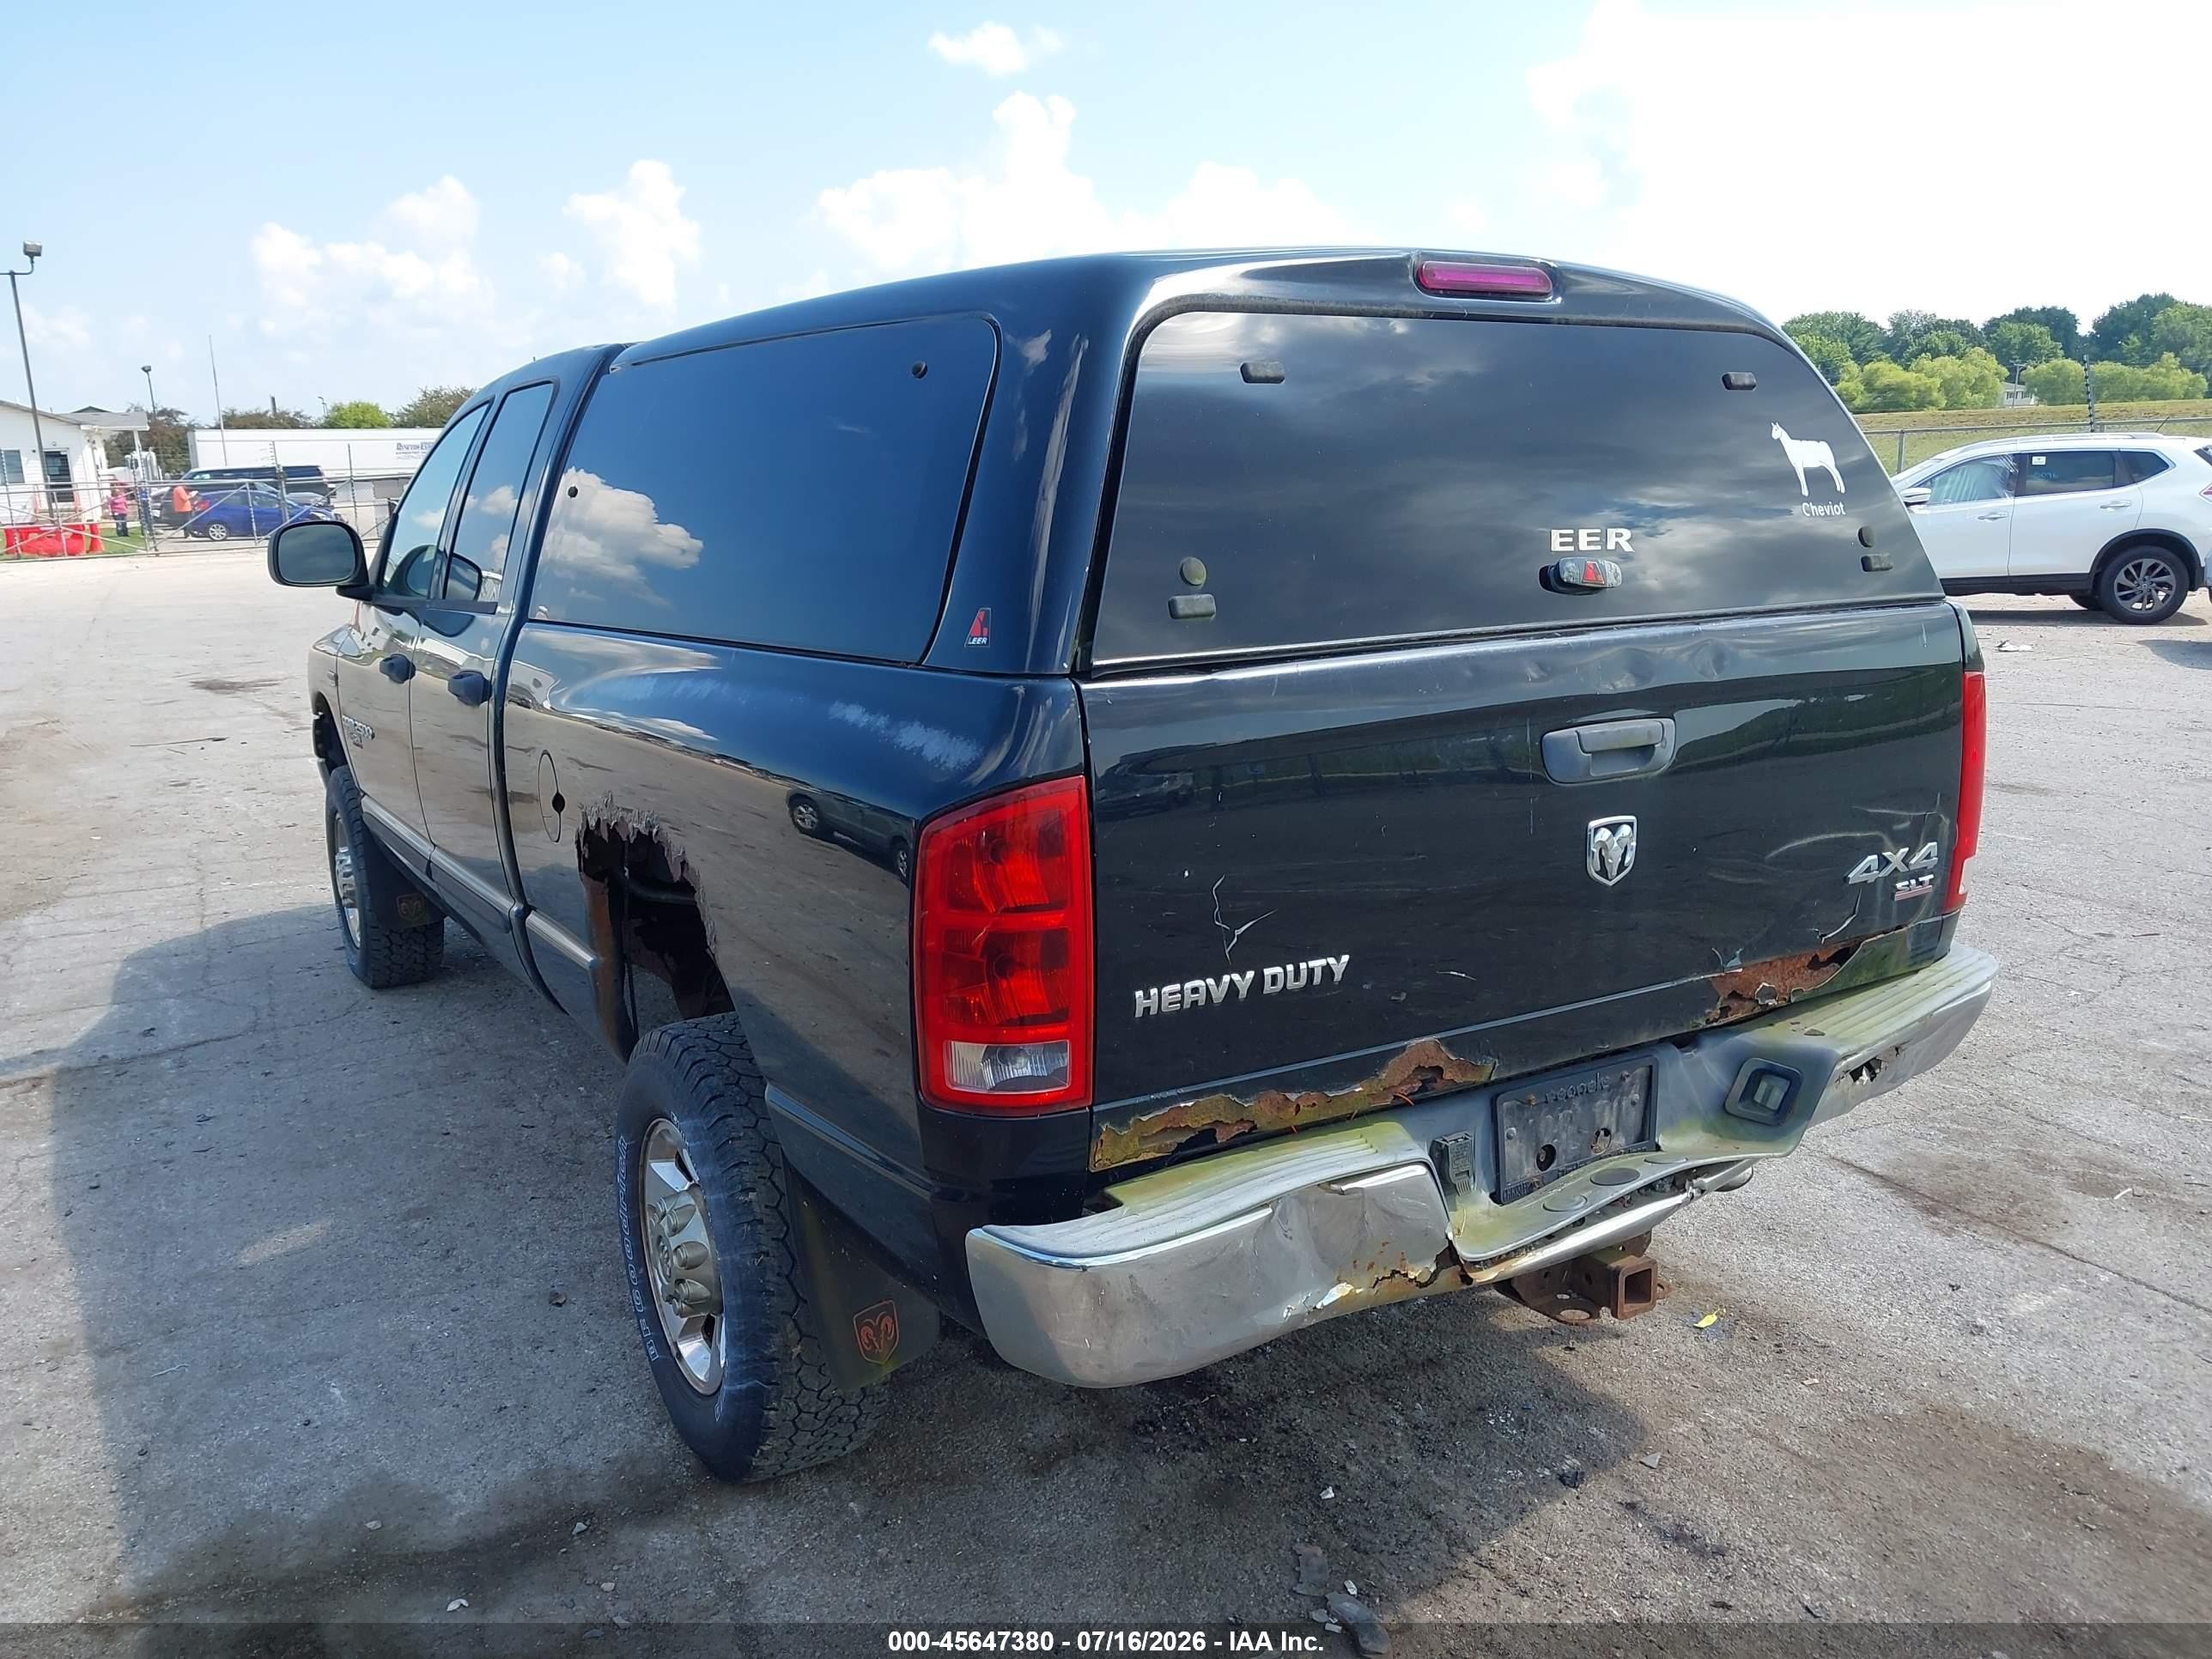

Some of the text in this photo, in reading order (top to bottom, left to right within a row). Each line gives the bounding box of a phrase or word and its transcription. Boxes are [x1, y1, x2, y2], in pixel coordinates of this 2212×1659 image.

[1802, 501, 1845, 518] Cheviot
[1550, 527, 1634, 553] EER
[1848, 842, 1939, 884] 4X4
[1895, 874, 1935, 891] SLT
[1134, 954, 1351, 1018] HEAVY DUTY
